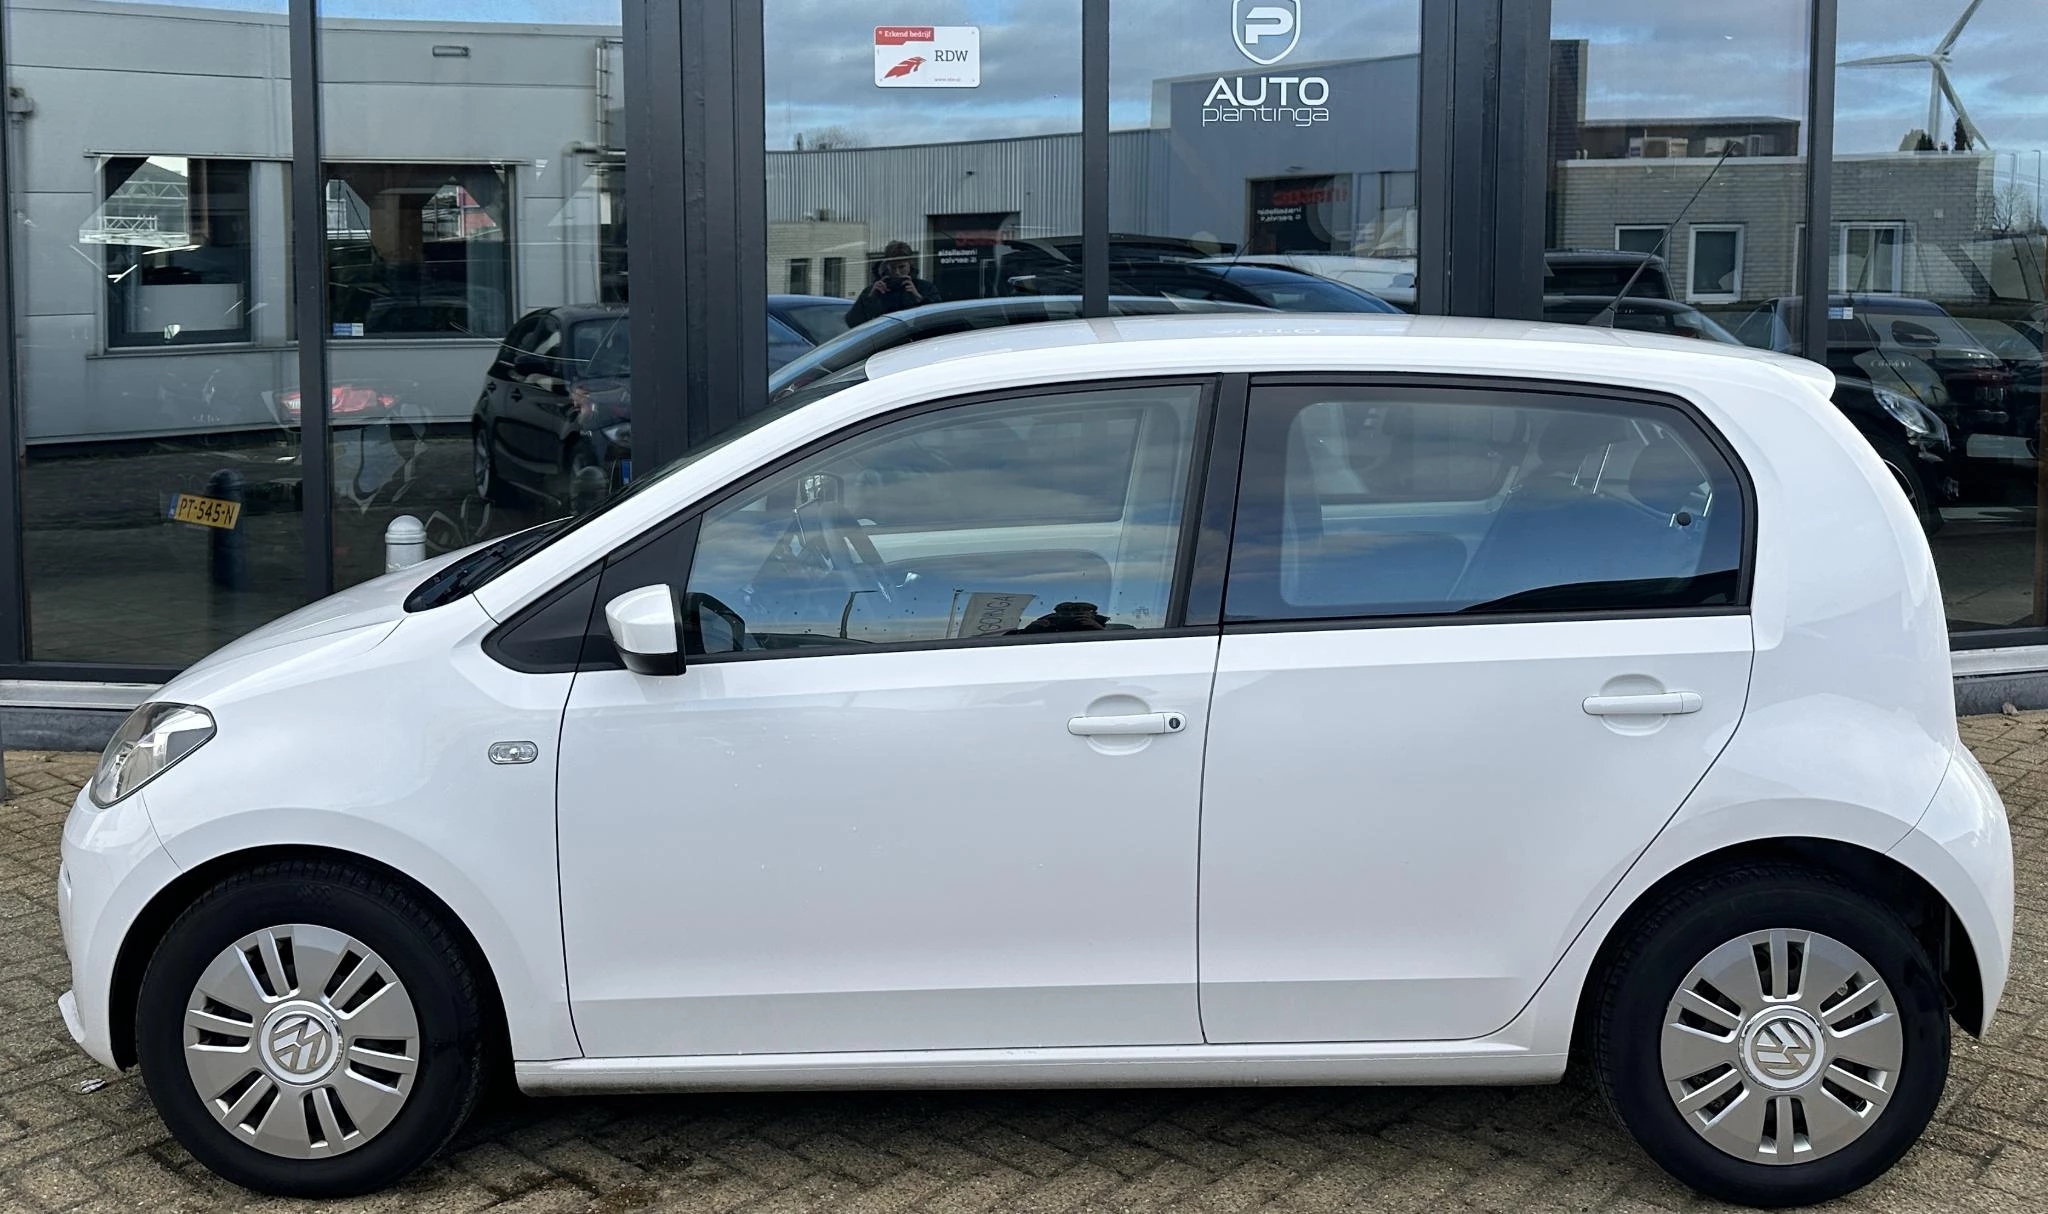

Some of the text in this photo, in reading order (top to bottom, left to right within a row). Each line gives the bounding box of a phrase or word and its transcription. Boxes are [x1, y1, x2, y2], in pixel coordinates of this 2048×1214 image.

[884, 30, 932, 39] Erkend bedrijf
[935, 49, 969, 62] RDW
[1203, 77, 1330, 106] AUTO
[1202, 105, 1330, 127] plantinga
[178, 497, 236, 526] PT-545-N
